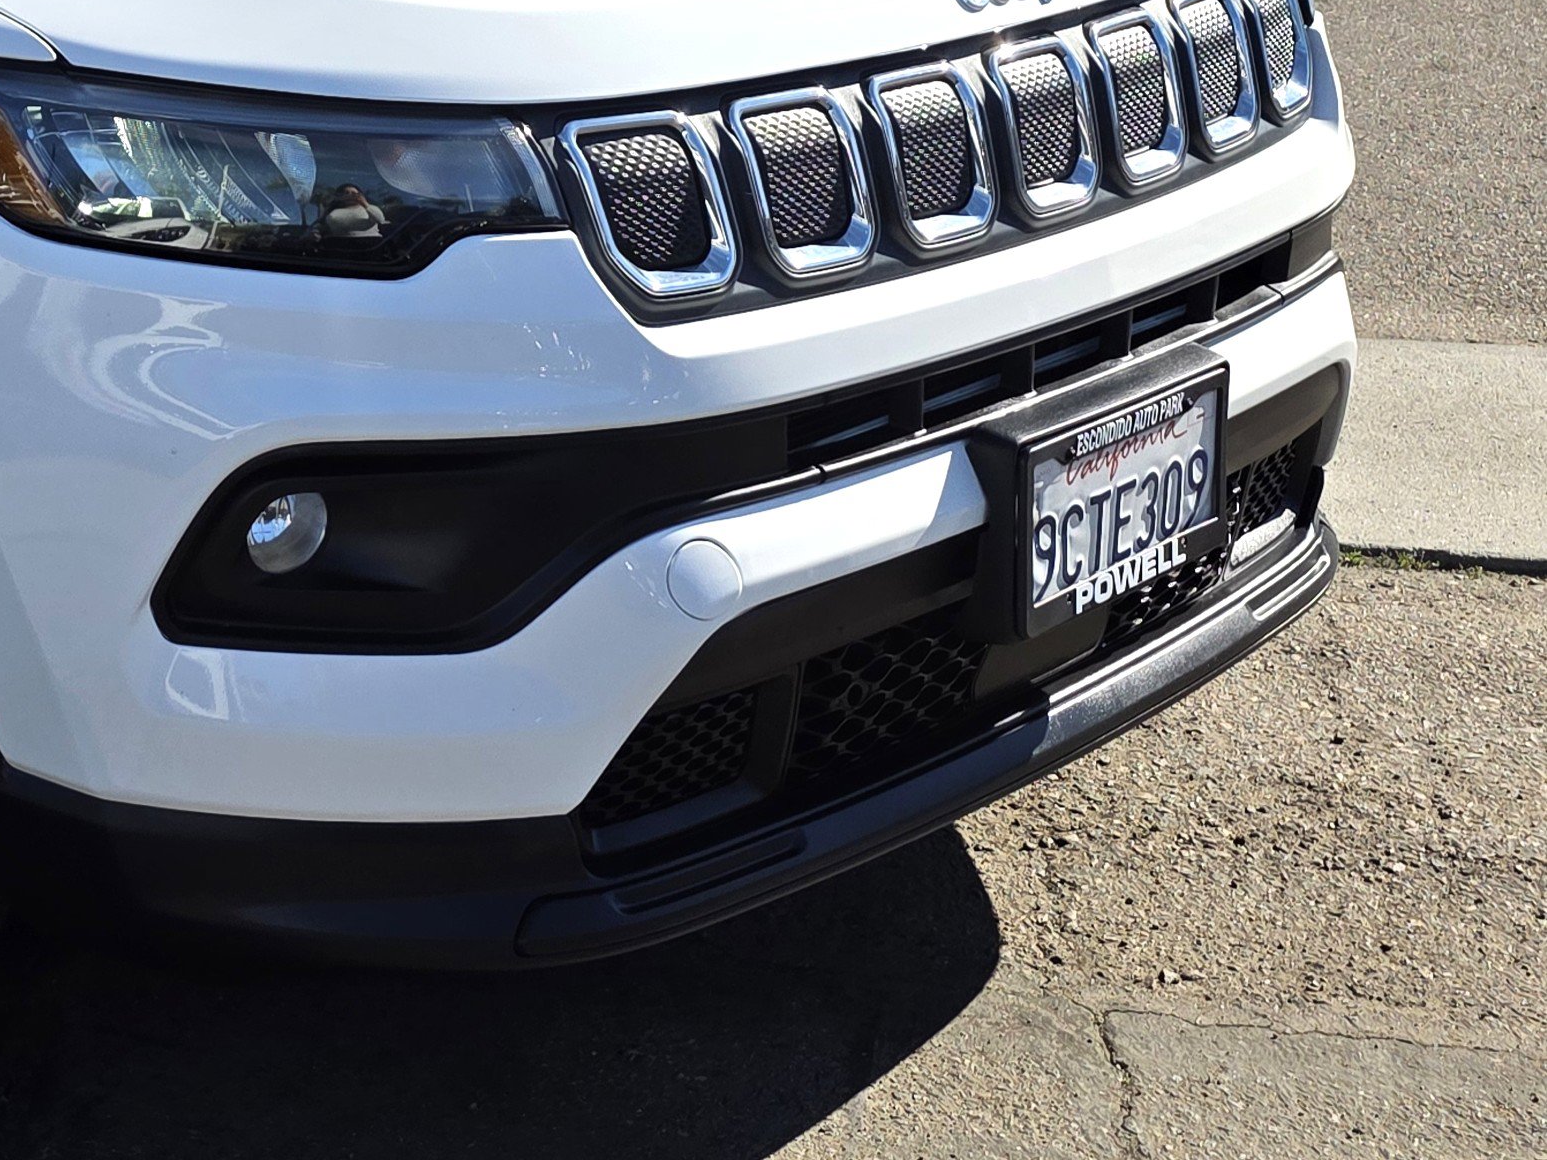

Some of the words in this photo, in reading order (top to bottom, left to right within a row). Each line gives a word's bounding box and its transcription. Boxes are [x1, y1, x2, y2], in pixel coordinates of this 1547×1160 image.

[1066, 419, 1187, 485] California
[1076, 415, 1133, 457] ESCONDIDO
[1133, 403, 1159, 434] AUTO
[1159, 392, 1185, 421] PARK
[1034, 449, 1209, 604] 9CTE309
[1076, 538, 1188, 615] POWELL
